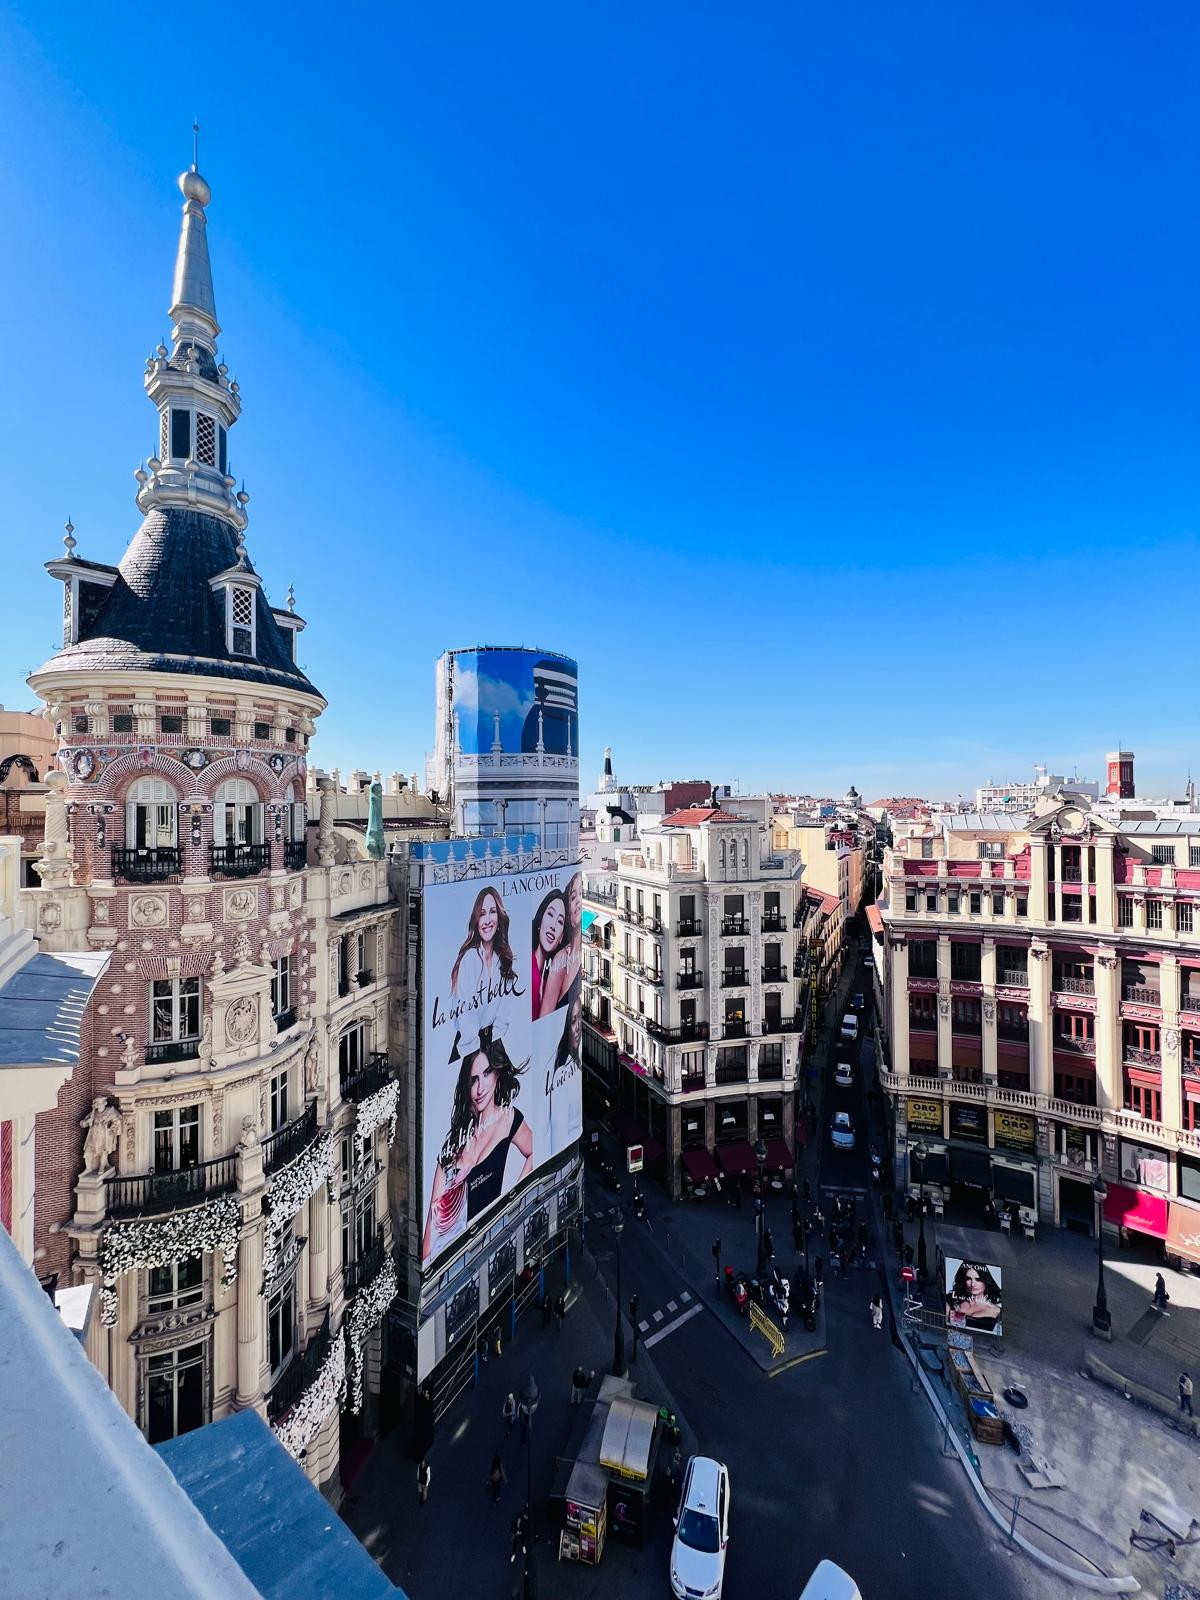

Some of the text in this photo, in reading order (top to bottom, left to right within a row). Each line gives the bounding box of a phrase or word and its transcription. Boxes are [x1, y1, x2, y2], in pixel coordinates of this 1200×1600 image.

[502, 873, 561, 897] LANCÔME
[432, 973, 526, 1029] La vie est belle
[913, 1104, 936, 1112] ORO
[1001, 1119, 1029, 1130] ORO
